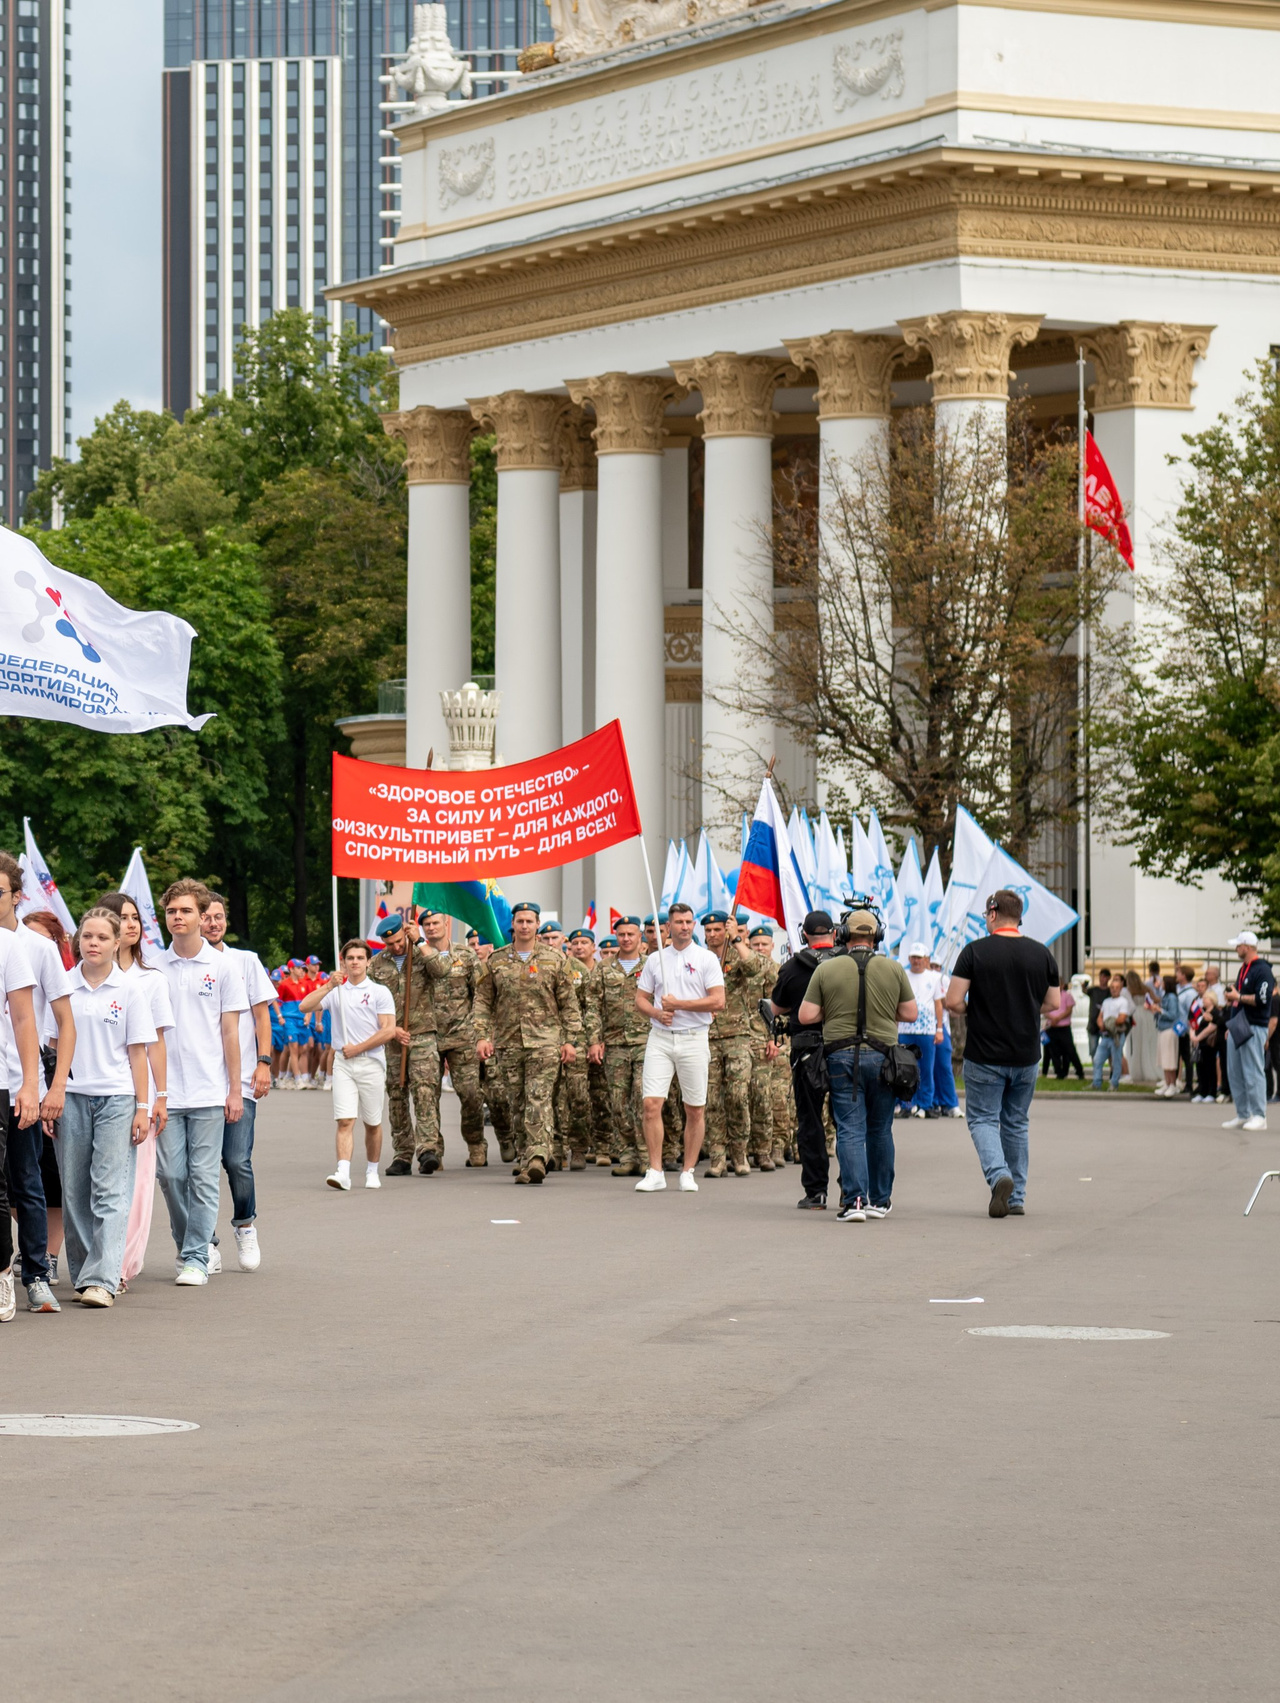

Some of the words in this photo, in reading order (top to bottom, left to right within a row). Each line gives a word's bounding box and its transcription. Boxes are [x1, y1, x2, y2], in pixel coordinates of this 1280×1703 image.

[507, 122, 627, 174] СОВЕТСКАЯ
[638, 73, 821, 141] ФЕДЕРАТИВНАЯ
[548, 59, 767, 139] РОССИЙСКАЯ
[507, 134, 689, 199] СОЦИАЛИСТИЧЕСКАЯ
[699, 102, 824, 155] РЕСПУБЛИКА
[368, 784, 475, 804] «ЗДОРОВОЕ
[480, 765, 579, 801] ОТЕЧЕСТВО»
[406, 807, 430, 823] ЗА
[435, 808, 484, 825] СИЛУ
[489, 807, 502, 821] И
[507, 790, 564, 820] УСПЕХ!
[332, 817, 495, 844] ФИЗКУЛЬТПРИВЕТ
[512, 819, 548, 841] ДЛЯ
[552, 788, 623, 829] КАЖДОГО,
[344, 840, 470, 864] СПОРТИВНЫЙ
[474, 843, 520, 863] ПУТЬ
[537, 834, 572, 856] ДЛЯ
[575, 813, 617, 843] ВСЕХ!
[103, 1017, 118, 1026] ФСП
